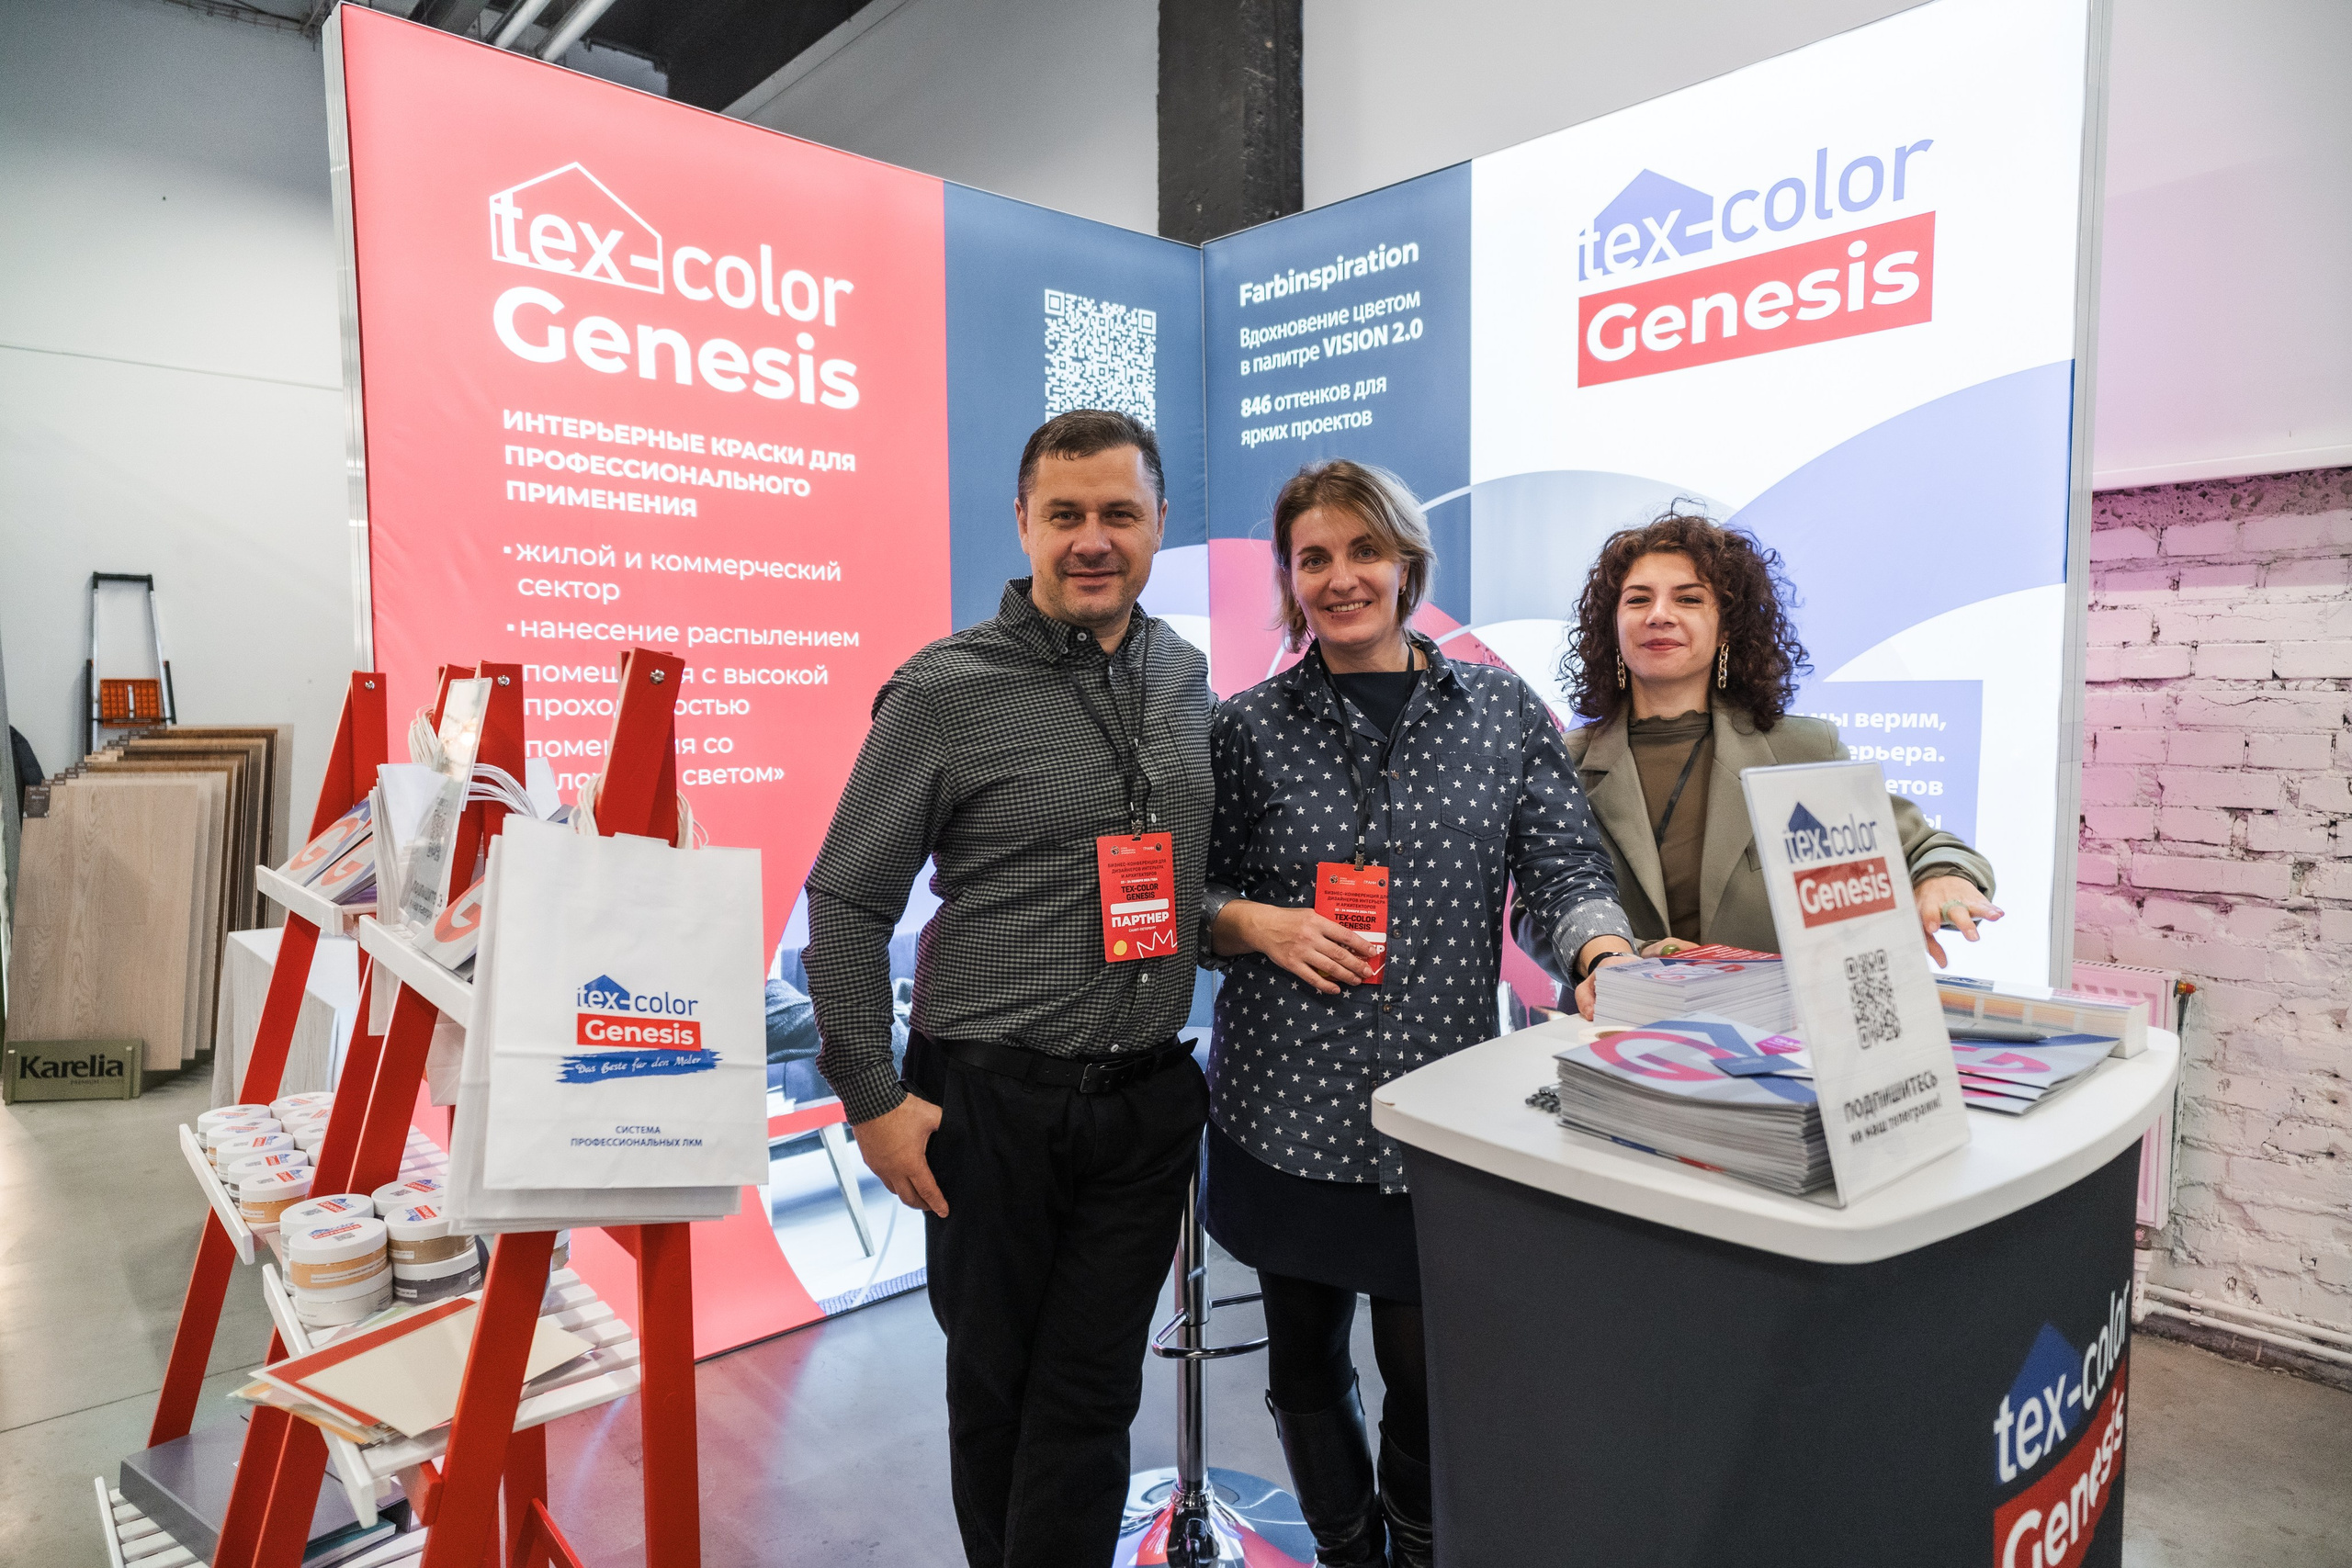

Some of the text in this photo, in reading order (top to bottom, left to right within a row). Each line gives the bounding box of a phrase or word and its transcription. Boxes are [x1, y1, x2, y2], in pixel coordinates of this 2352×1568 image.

[1577, 139, 1935, 283] tex-color
[491, 190, 855, 328] tex-color
[1238, 241, 1420, 308] Farbinspiration
[1586, 239, 1921, 363] Genesis
[1239, 290, 1421, 350] Вдохновение цветом
[492, 286, 861, 410] Genesis
[1240, 318, 1424, 376] в палитре VISION 2.0
[1240, 375, 1387, 419] 846 оттенков для
[503, 409, 856, 473] ИНТЕРЬЕРНЫЕ КРАСКИ ДЛЯ
[1240, 410, 1373, 448] ярких проектов
[504, 444, 811, 497] ПРОФЕССИОНАЛЬНОГО
[506, 479, 698, 518] ПРИМЕНЕНИЯ
[515, 542, 842, 582] жилой и коммерческий
[517, 575, 621, 604] сектор
[520, 619, 860, 648] нанесение распылением
[702, 667, 717, 685] с
[723, 662, 830, 686] высокой
[1854, 712, 1947, 733] верим,
[703, 735, 733, 755] со
[682, 764, 785, 786] светом»
[1121, 883, 1159, 893] TEX-COLOR
[1125, 892, 1155, 900] GENESIS
[1799, 863, 1893, 915] Genesis
[1111, 911, 1170, 928] ПАРТНЕР
[1334, 913, 1377, 923] TEX-COLOR
[576, 985, 699, 1016] tex-color
[584, 1019, 695, 1045] Genesis
[19, 1053, 124, 1079] Karelia
[650, 1056, 670, 1068] den
[570, 1138, 704, 1147] ПРОФЕССИОНАЛЬНЫХ ЛКМ
[616, 1125, 662, 1134] СИСТЕМА
[1993, 1279, 2132, 1483] tex-color
[2001, 1387, 2125, 1568] Genesis
